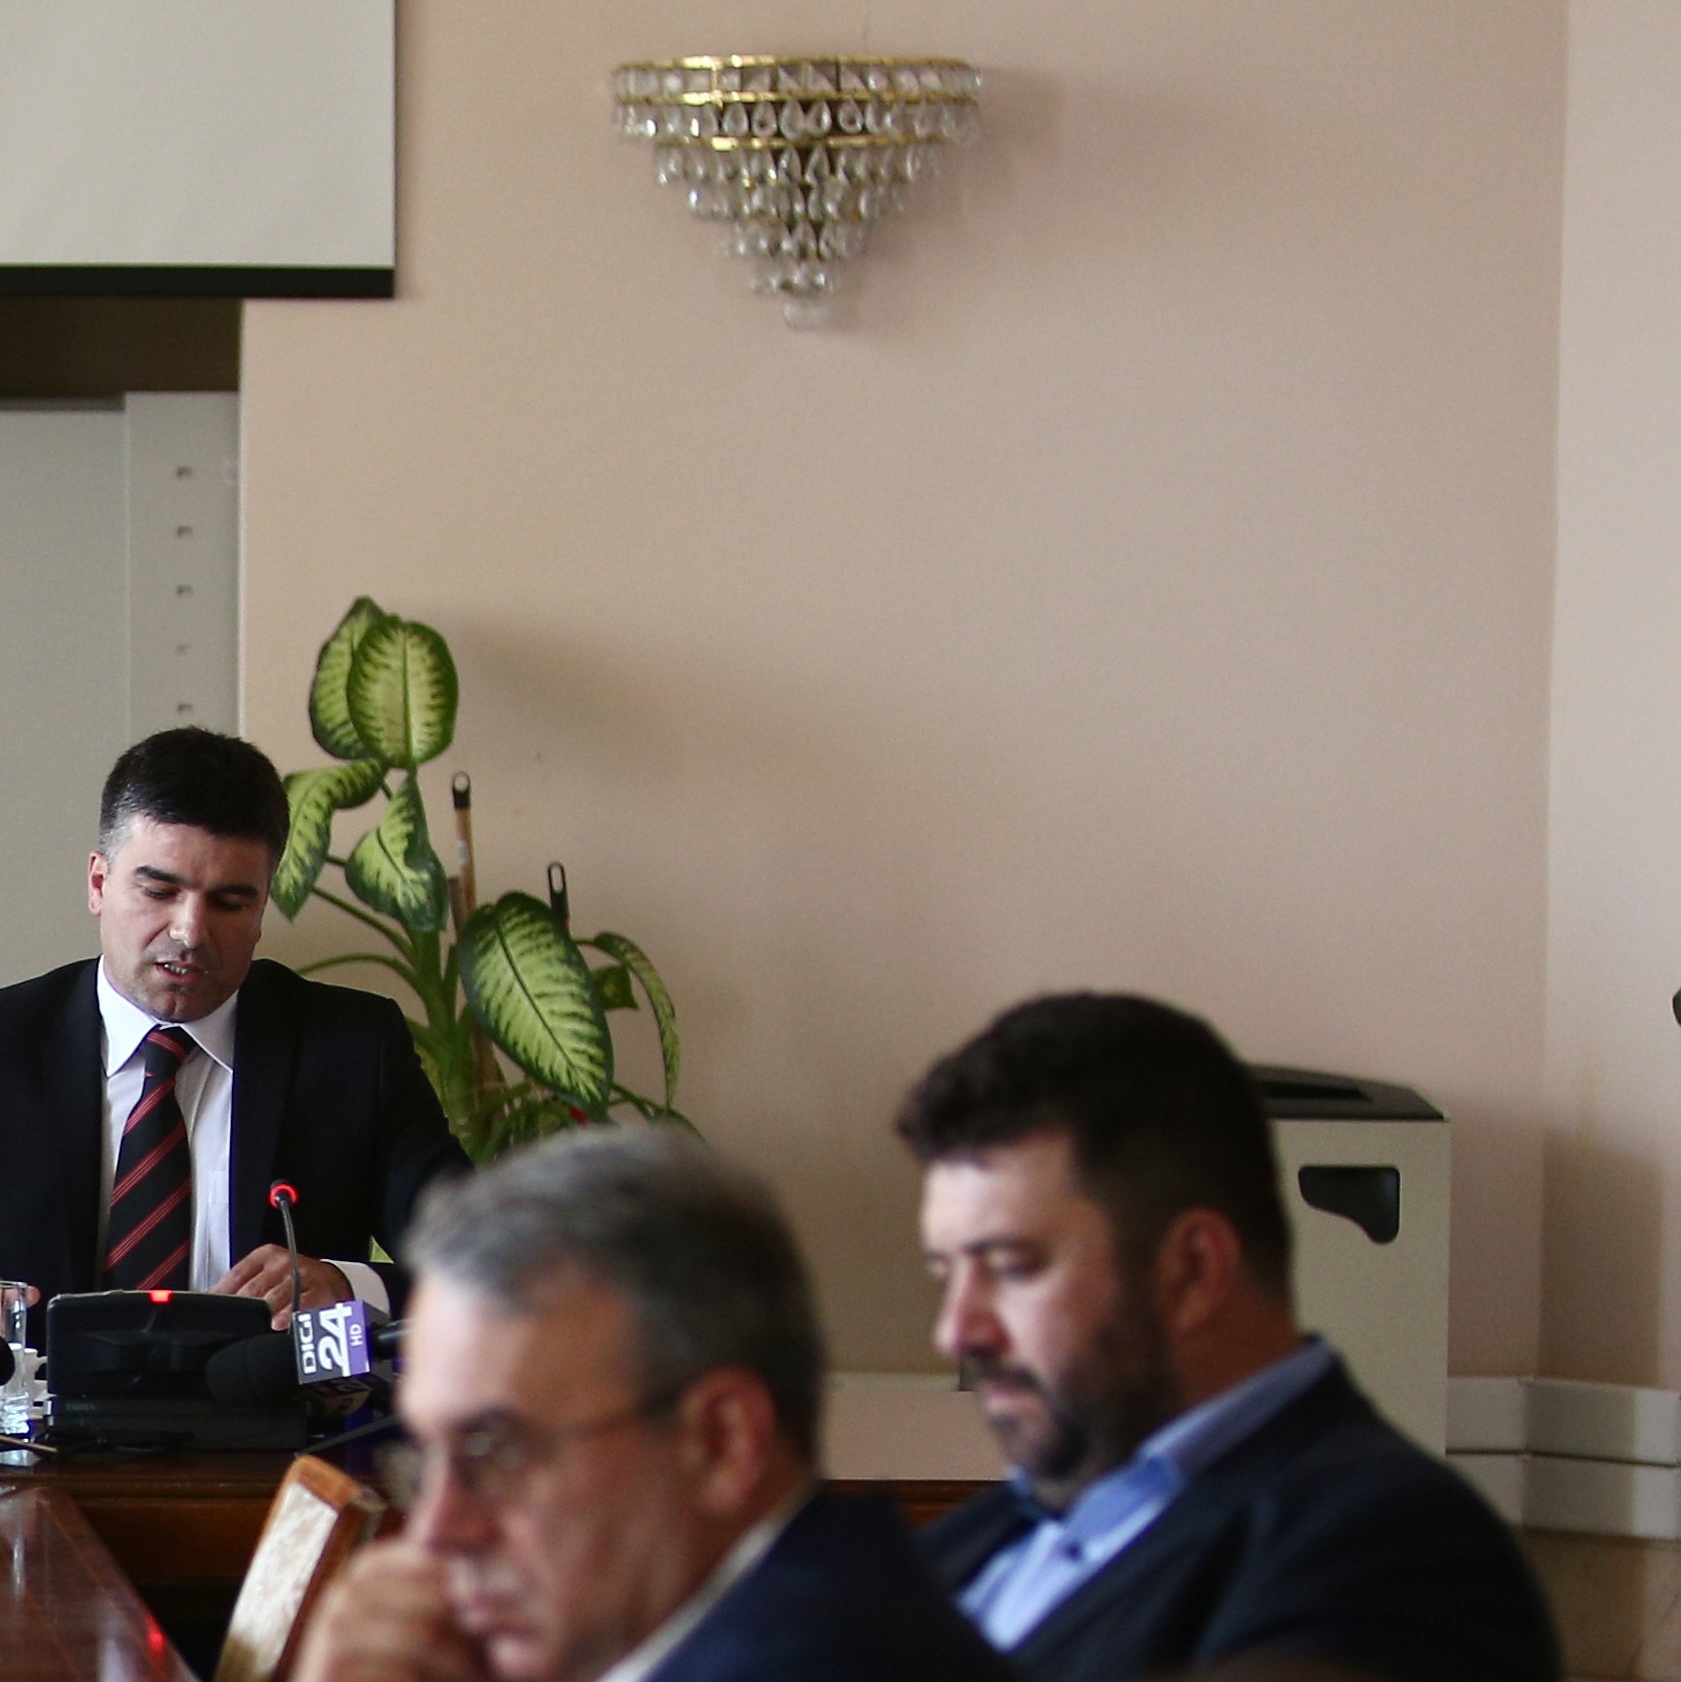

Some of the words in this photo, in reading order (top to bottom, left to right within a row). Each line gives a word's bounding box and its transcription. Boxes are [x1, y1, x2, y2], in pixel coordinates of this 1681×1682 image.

[297, 1313, 317, 1374] DIGI
[318, 1303, 353, 1377] 24
[349, 1324, 364, 1347] HD
